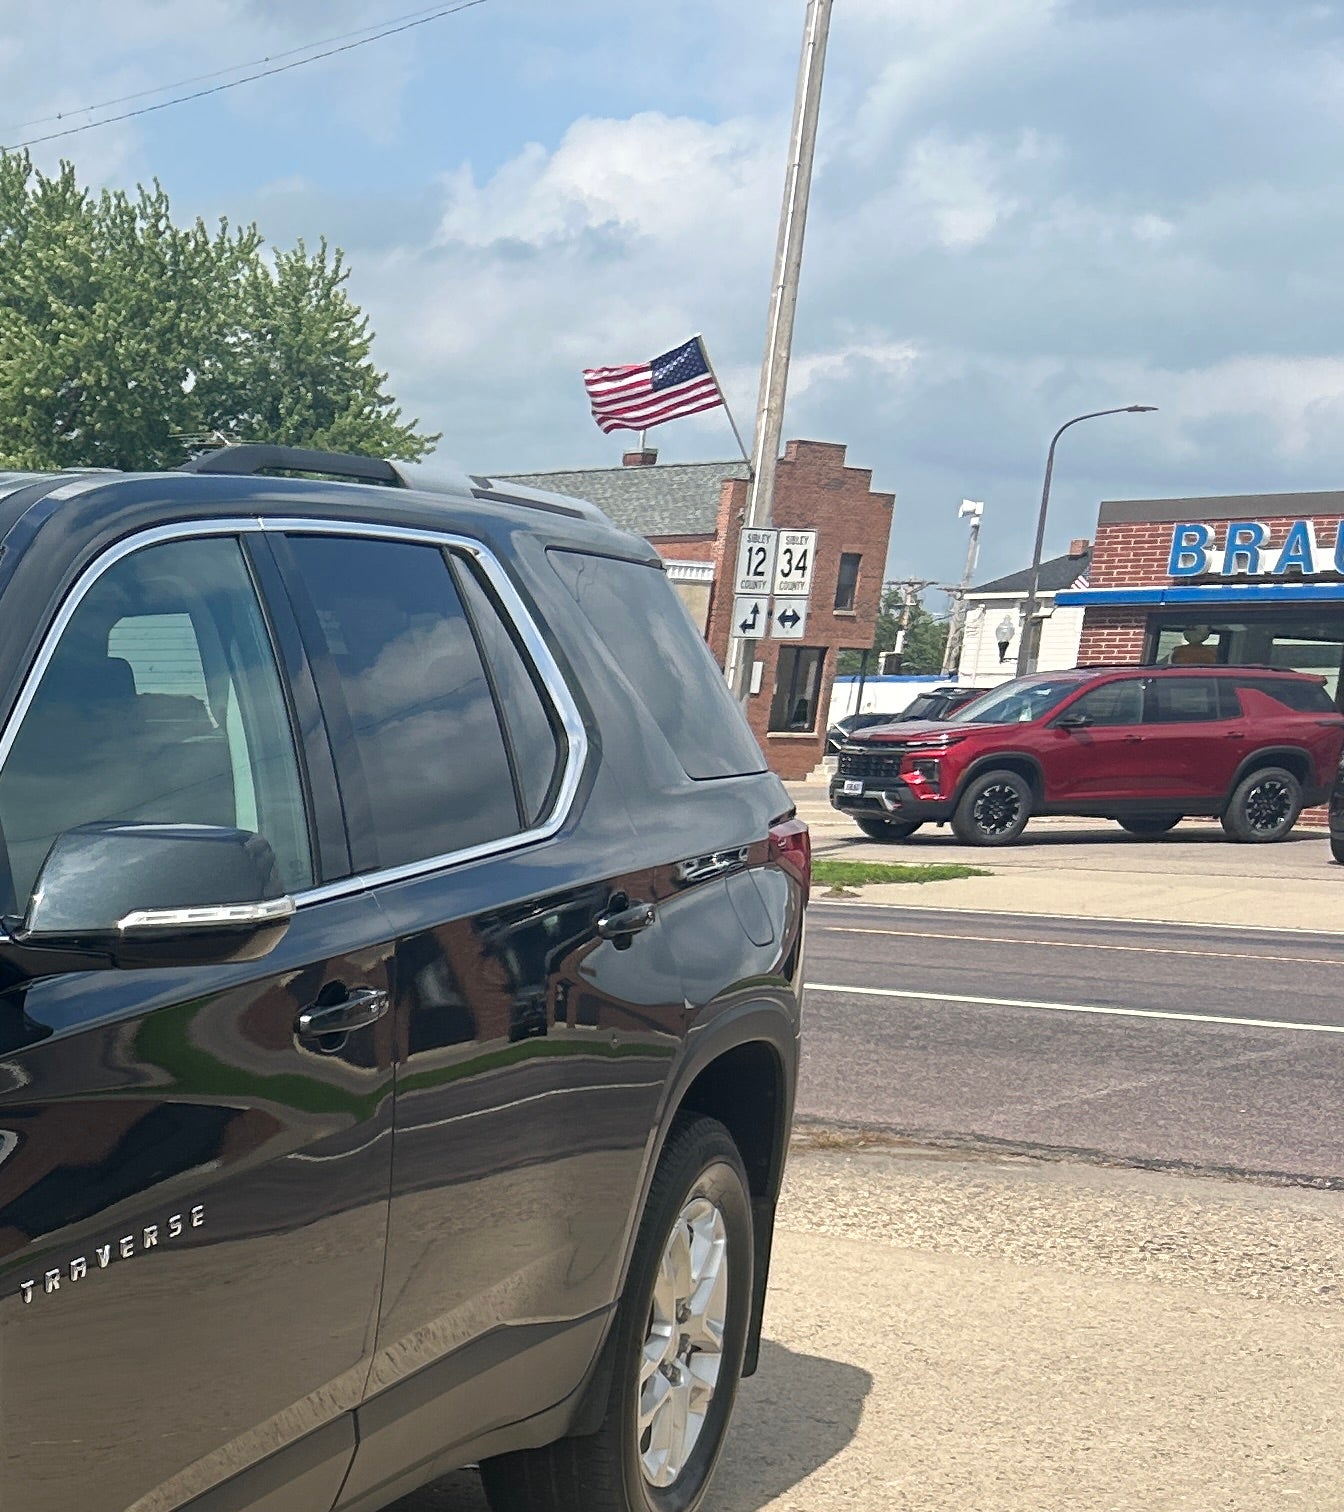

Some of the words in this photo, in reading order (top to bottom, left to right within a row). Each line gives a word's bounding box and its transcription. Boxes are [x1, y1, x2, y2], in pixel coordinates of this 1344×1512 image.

[746, 533, 771, 544] SIBLEY
[785, 535, 810, 546] SIBLEY
[1167, 520, 1344, 577] BRA
[746, 546, 767, 577] 12
[780, 547, 808, 578] 34
[740, 580, 767, 590] COUNTY
[779, 581, 806, 591] COUNTY
[20, 1204, 205, 1304] TRAVERSE
